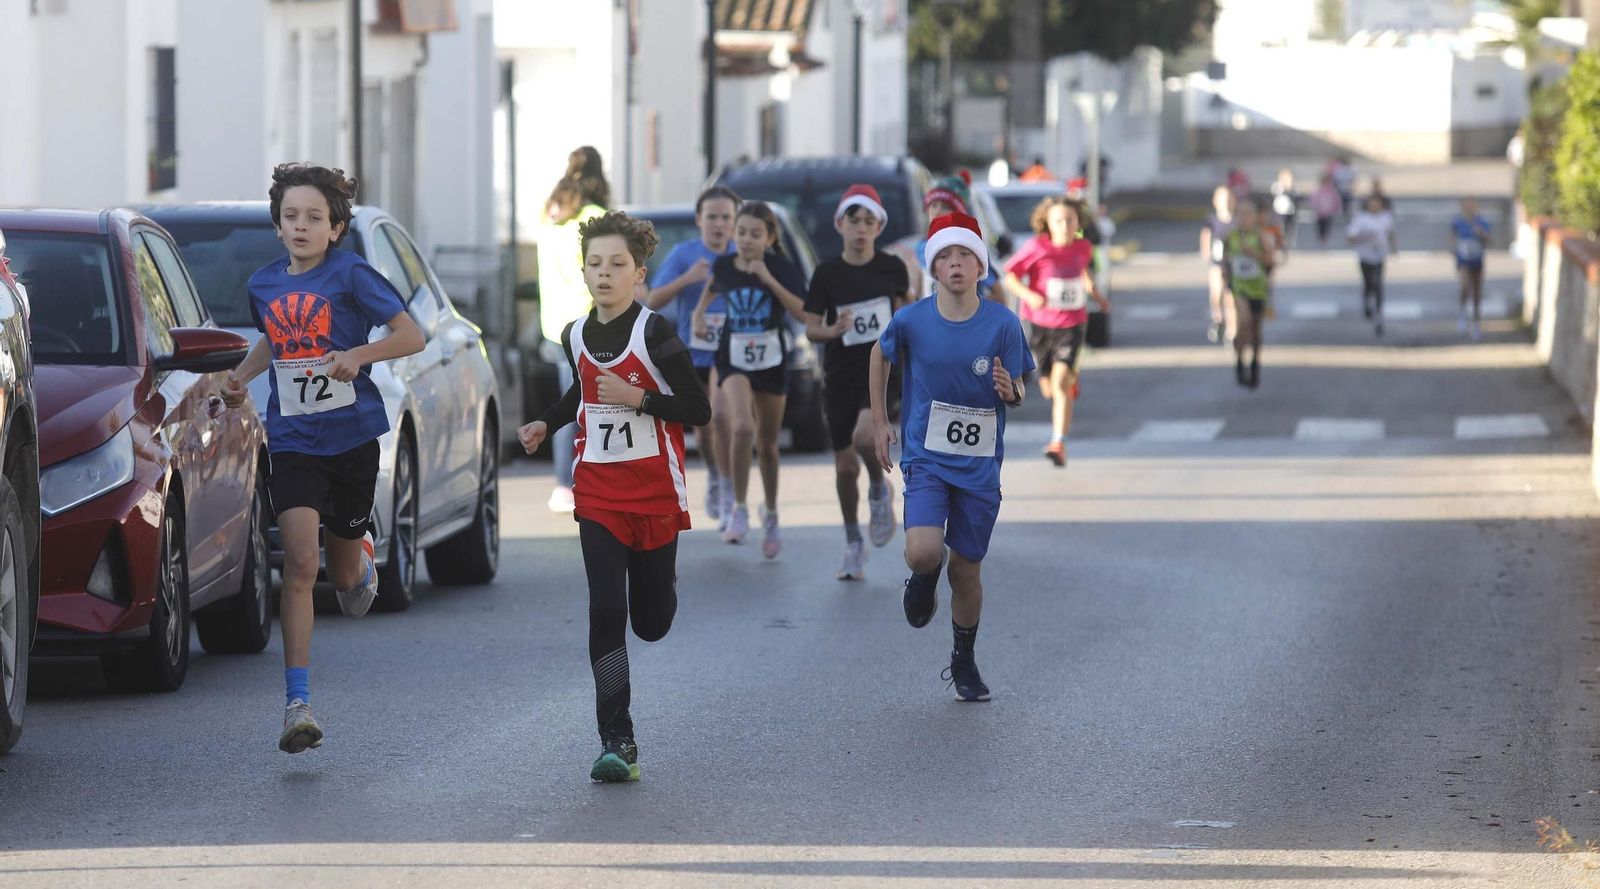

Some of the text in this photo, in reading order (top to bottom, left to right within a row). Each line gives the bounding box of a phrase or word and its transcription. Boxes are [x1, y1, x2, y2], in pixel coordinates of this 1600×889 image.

[854, 313, 881, 334] 64
[745, 345, 767, 363] 57
[293, 374, 333, 404] 72
[598, 421, 634, 451] 71
[947, 421, 981, 447] 68
